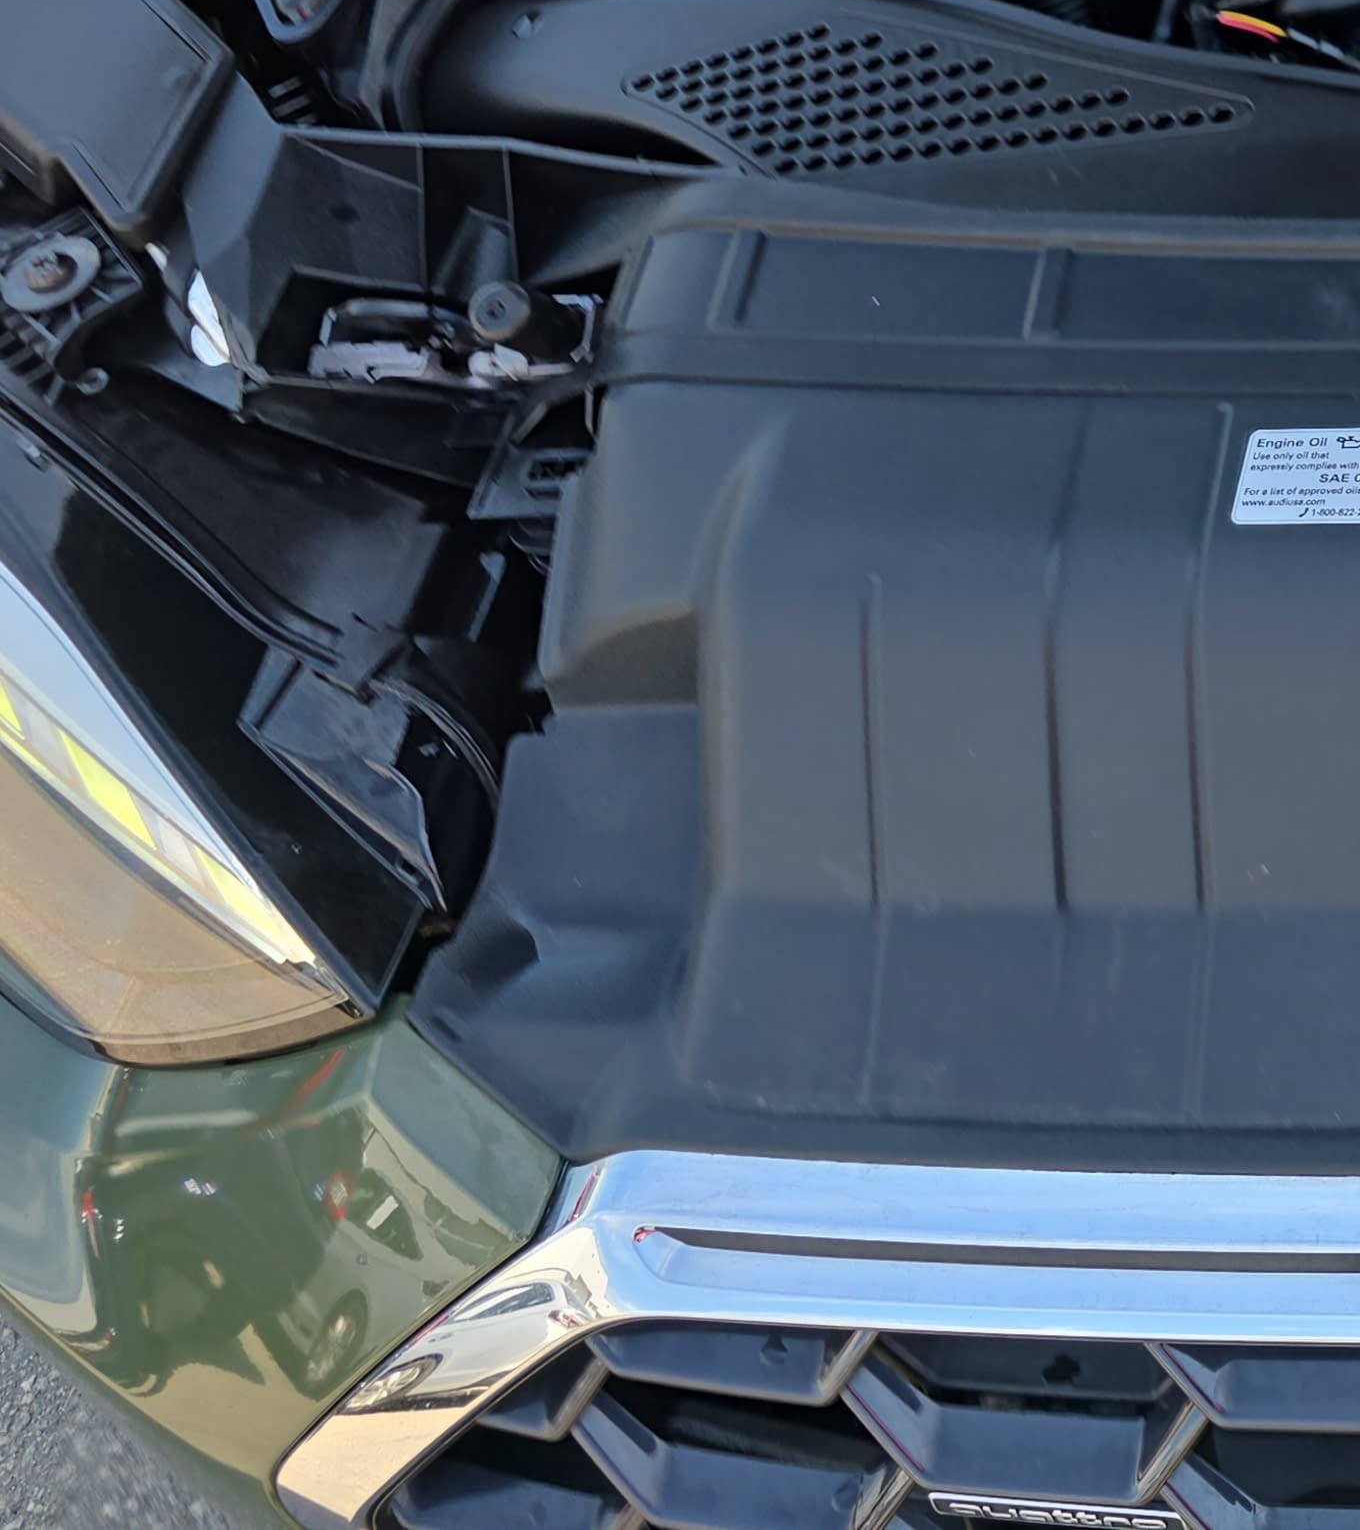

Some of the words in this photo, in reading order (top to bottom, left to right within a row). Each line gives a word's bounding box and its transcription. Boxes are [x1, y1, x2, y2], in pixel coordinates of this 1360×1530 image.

[1257, 438, 1304, 449] Engine
[1309, 437, 1328, 447] Oil
[1253, 452, 1270, 460] Use
[1273, 452, 1294, 460] only
[1250, 463, 1294, 471] expressly
[1296, 463, 1337, 471] complies
[1319, 473, 1350, 483] SAE
[1244, 487, 1259, 495] For
[1286, 487, 1297, 495] of
[1298, 487, 1343, 496] approved
[1241, 498, 1326, 506] www.audiusa.com
[949, 1502, 1167, 1530] quattro
